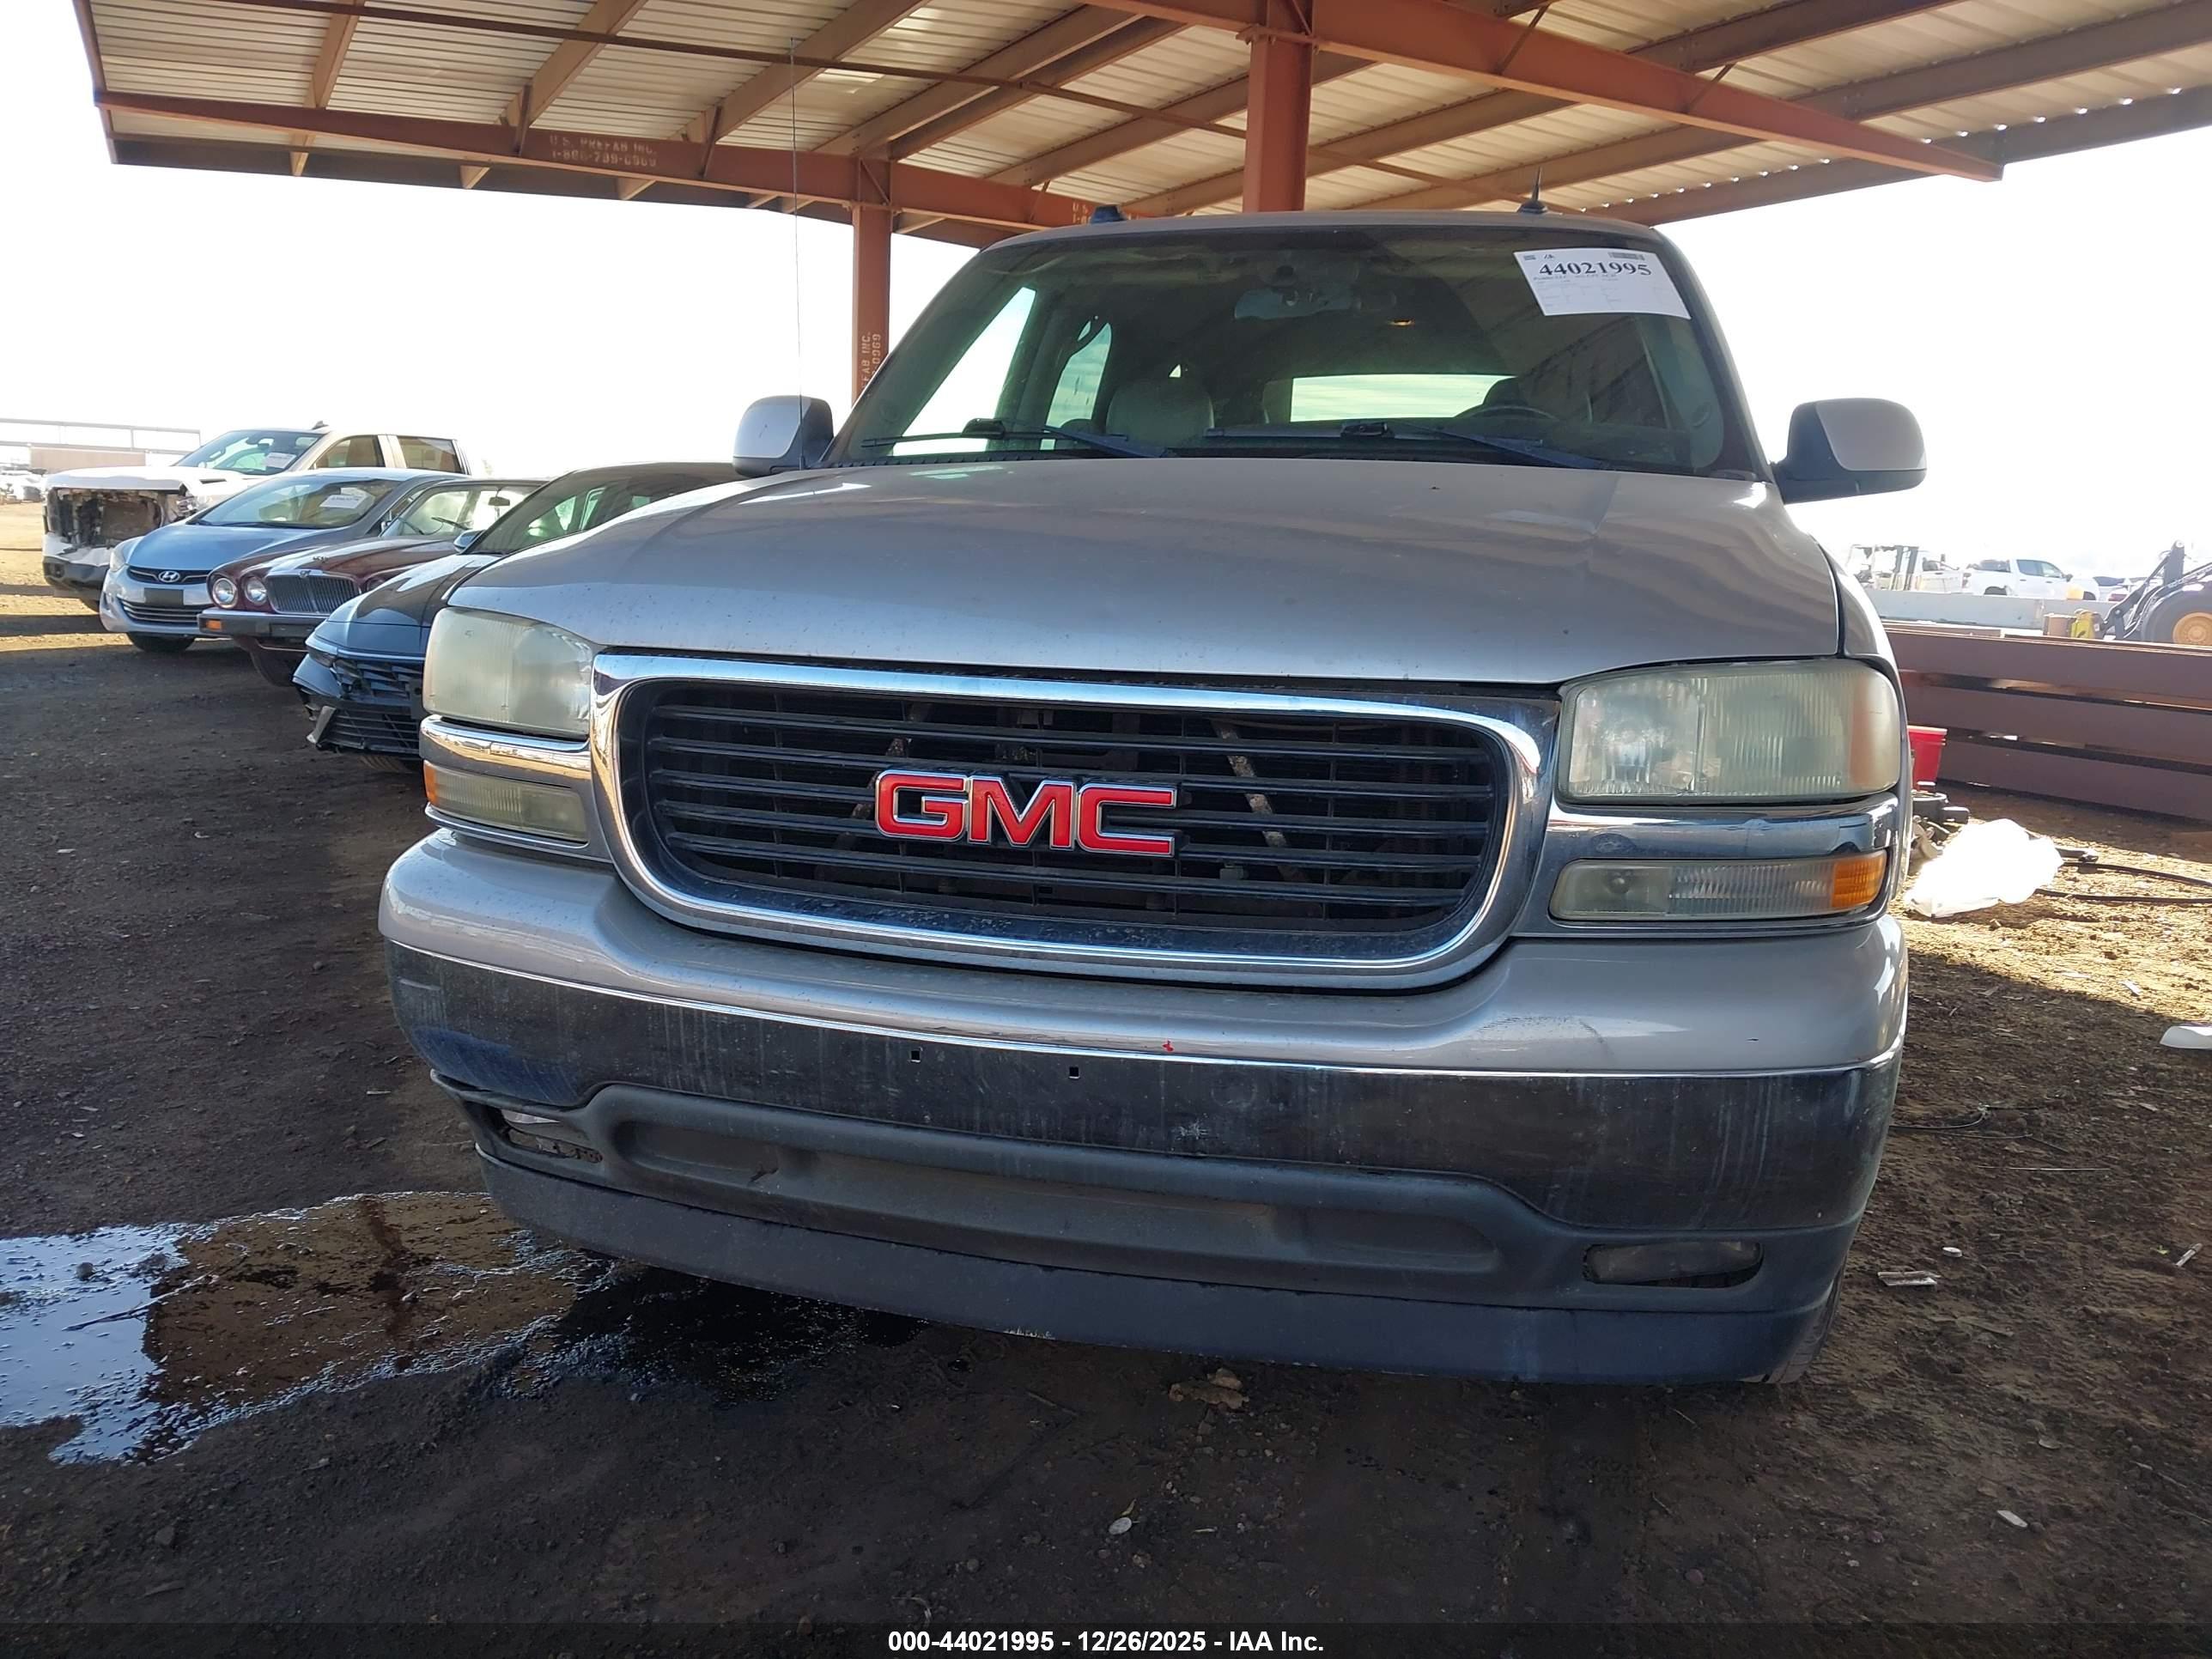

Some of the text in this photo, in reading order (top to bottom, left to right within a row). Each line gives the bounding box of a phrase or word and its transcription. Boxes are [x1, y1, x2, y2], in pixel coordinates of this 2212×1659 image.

[580, 136, 629, 152] PREFAB
[1539, 261, 1652, 276] 44021995
[875, 769, 1178, 856] GMC
